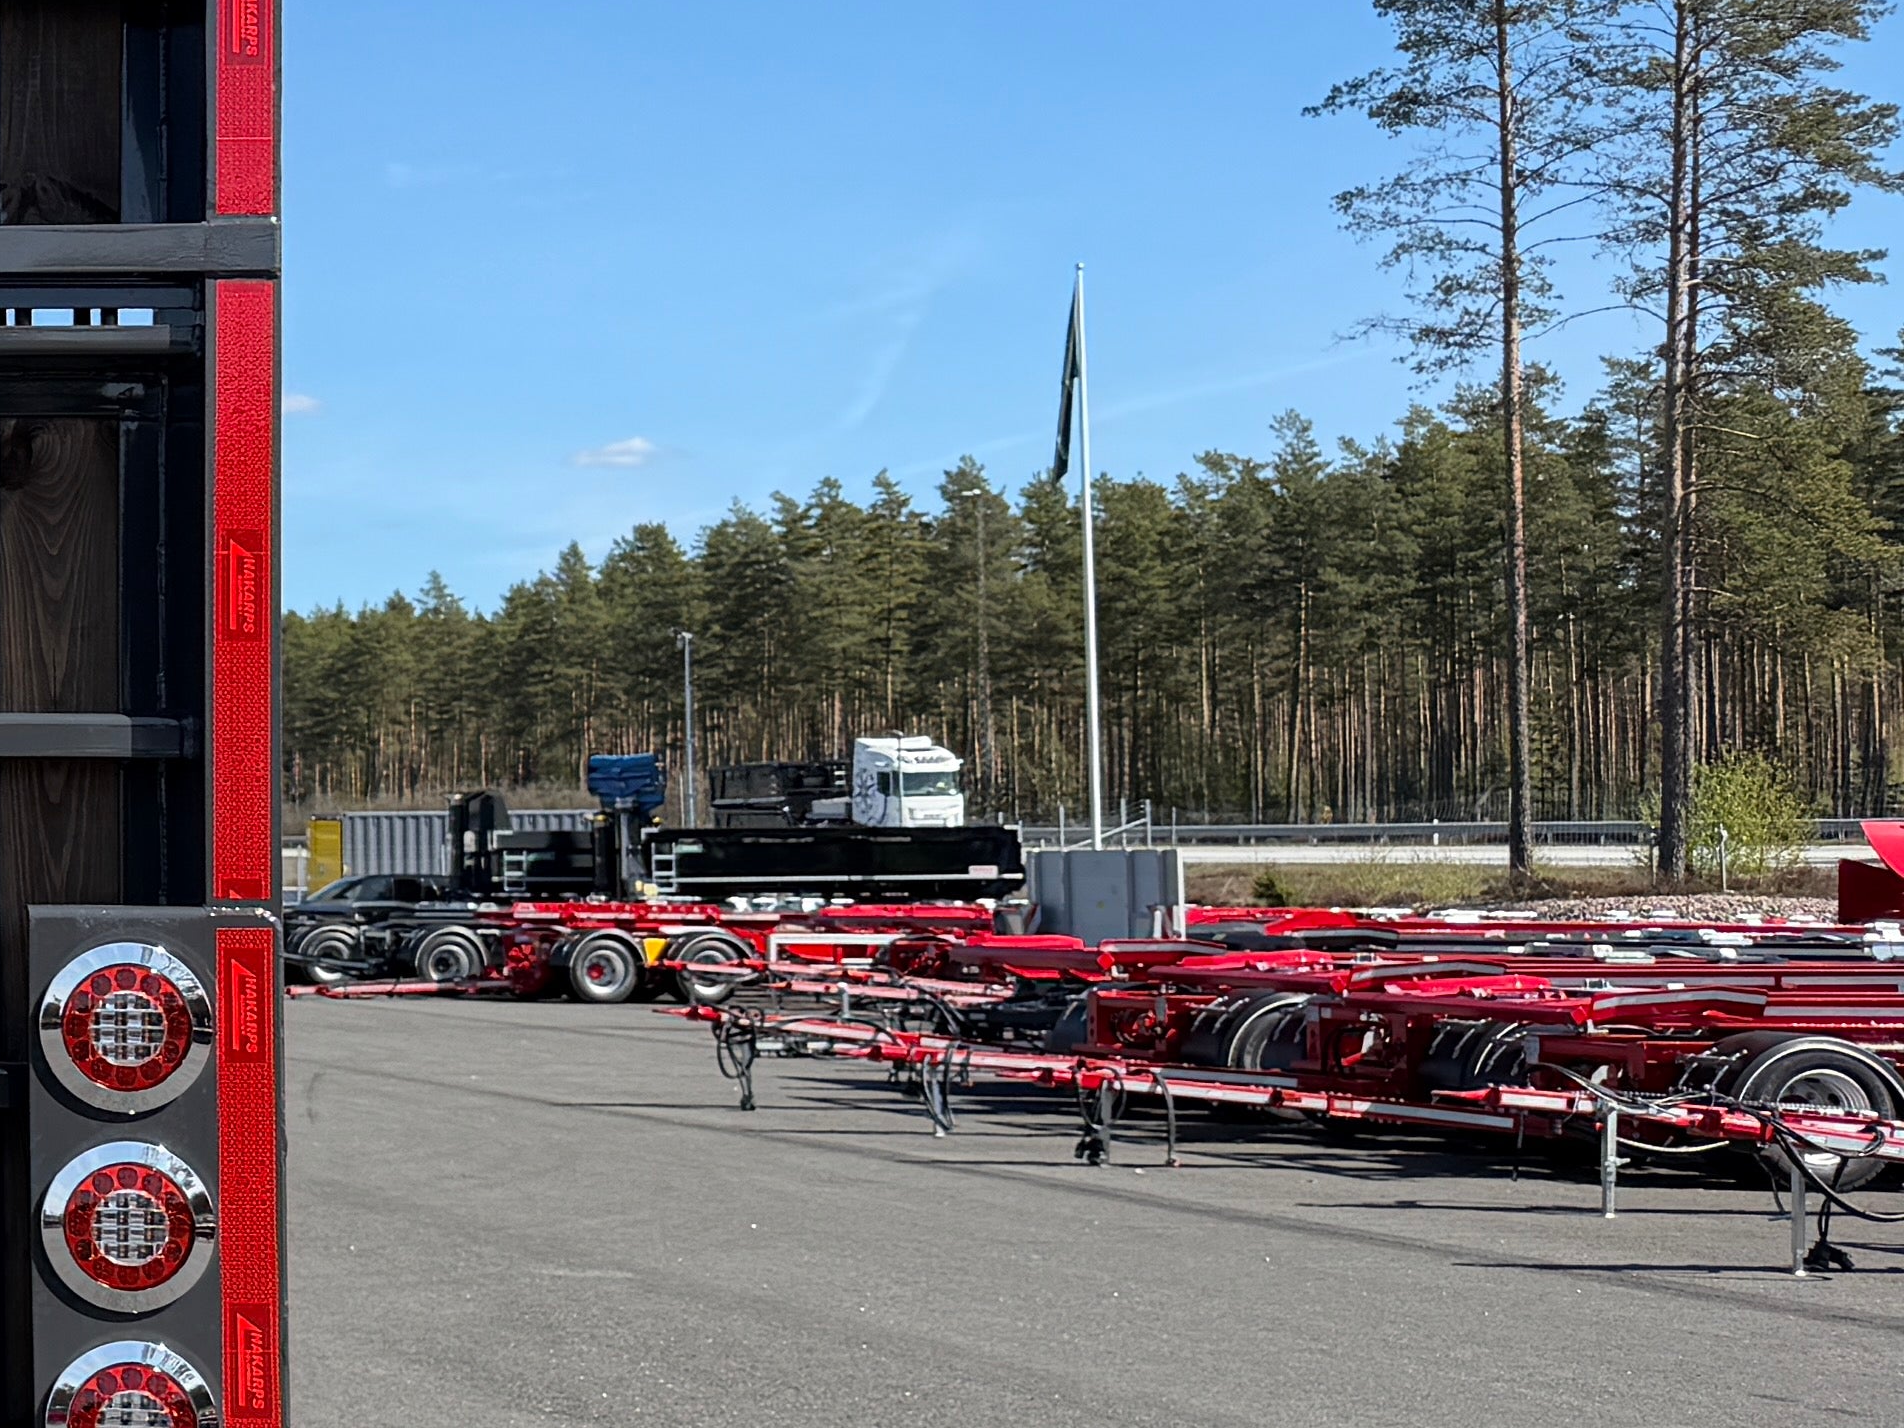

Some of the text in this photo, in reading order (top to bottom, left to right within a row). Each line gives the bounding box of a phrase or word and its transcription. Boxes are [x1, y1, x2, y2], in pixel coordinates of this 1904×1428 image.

[243, 558, 256, 633] HAKARPS
[245, 977, 258, 1053] HAKARPS
[250, 1333, 265, 1409] HAKARPS
